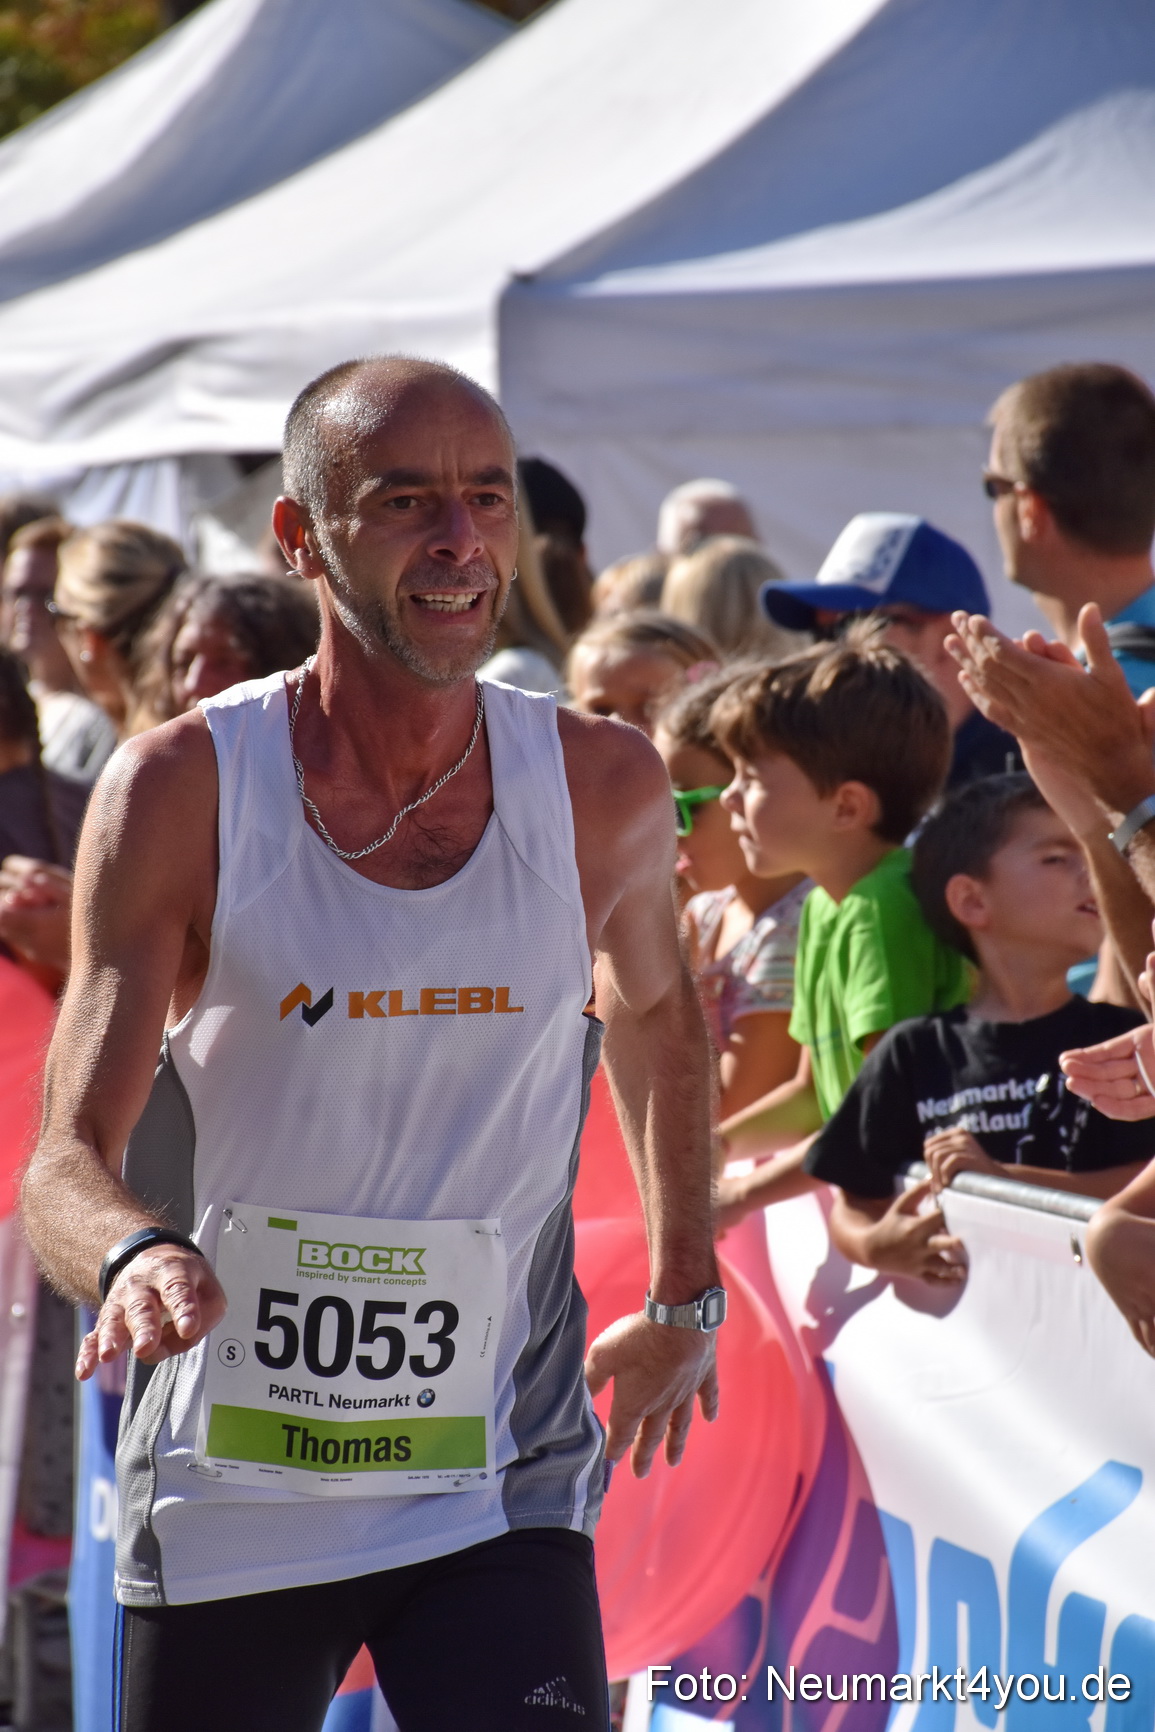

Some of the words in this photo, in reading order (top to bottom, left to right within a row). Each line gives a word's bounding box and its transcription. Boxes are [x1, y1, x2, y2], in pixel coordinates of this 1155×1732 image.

[348, 986, 525, 1019] KLEBL
[297, 1239, 427, 1275] BOCK
[296, 1268, 335, 1281] inspired
[338, 1271, 350, 1284] by
[352, 1274, 382, 1285] smart
[383, 1277, 427, 1288] concepts
[254, 1287, 459, 1381] 5053
[268, 1383, 324, 1407] PARTL
[328, 1394, 411, 1410] Neumarkt
[281, 1423, 412, 1465] Thomas
